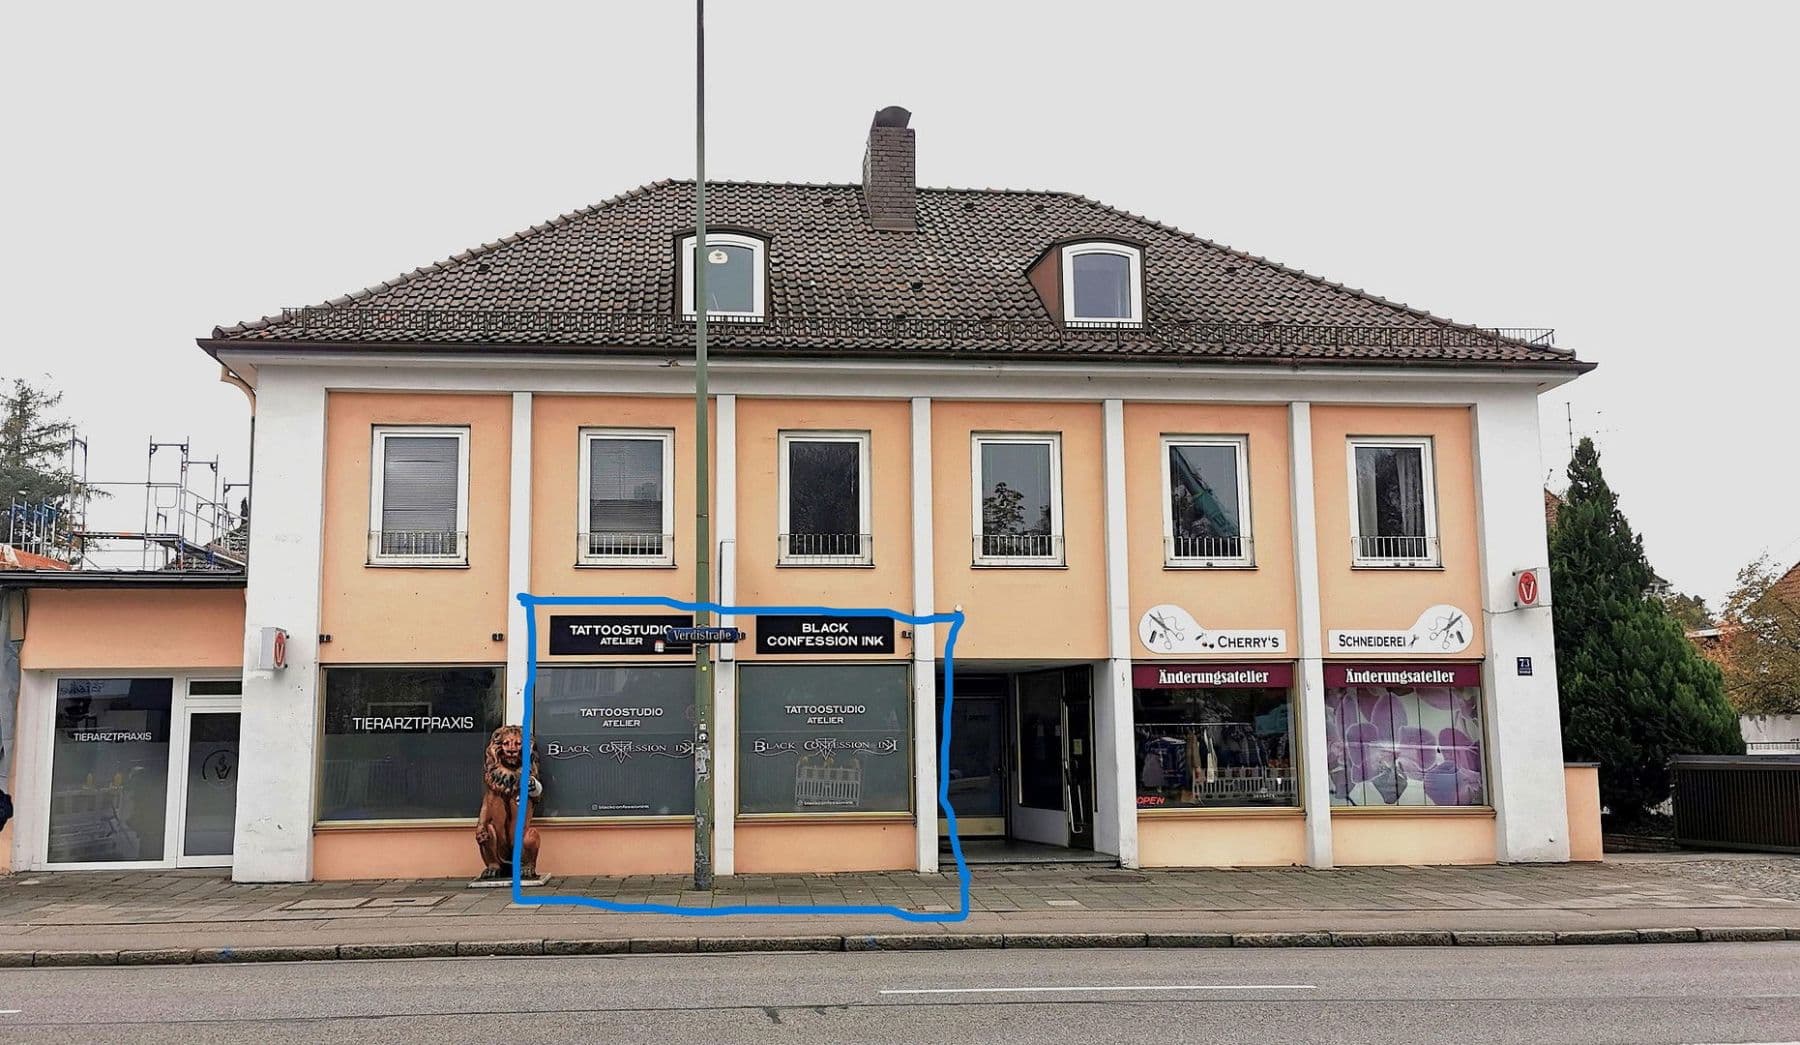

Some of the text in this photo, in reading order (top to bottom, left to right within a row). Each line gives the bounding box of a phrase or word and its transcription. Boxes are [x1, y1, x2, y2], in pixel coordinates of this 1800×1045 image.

[801, 622, 850, 633] BLACK
[673, 629, 732, 641] Verdistraße
[599, 636, 643, 646] ATELIER
[766, 635, 884, 647] CONFESSION INK
[1217, 634, 1280, 649] CHERRY'S
[1338, 634, 1406, 648] SCHNEIDEREI
[1158, 668, 1270, 686] Änderungsatelier
[1345, 668, 1456, 685] Änderungsatelier
[579, 707, 664, 718] TATTOOSTUDIO
[784, 704, 866, 715] TATTOOSTUDIO
[352, 716, 474, 730] TIERARZTPRAXIS
[602, 719, 641, 728] ATELIER
[806, 716, 845, 725] ATELIER
[73, 731, 152, 742] TIERARZTPRAXIS
[1136, 795, 1166, 805] OPEN
